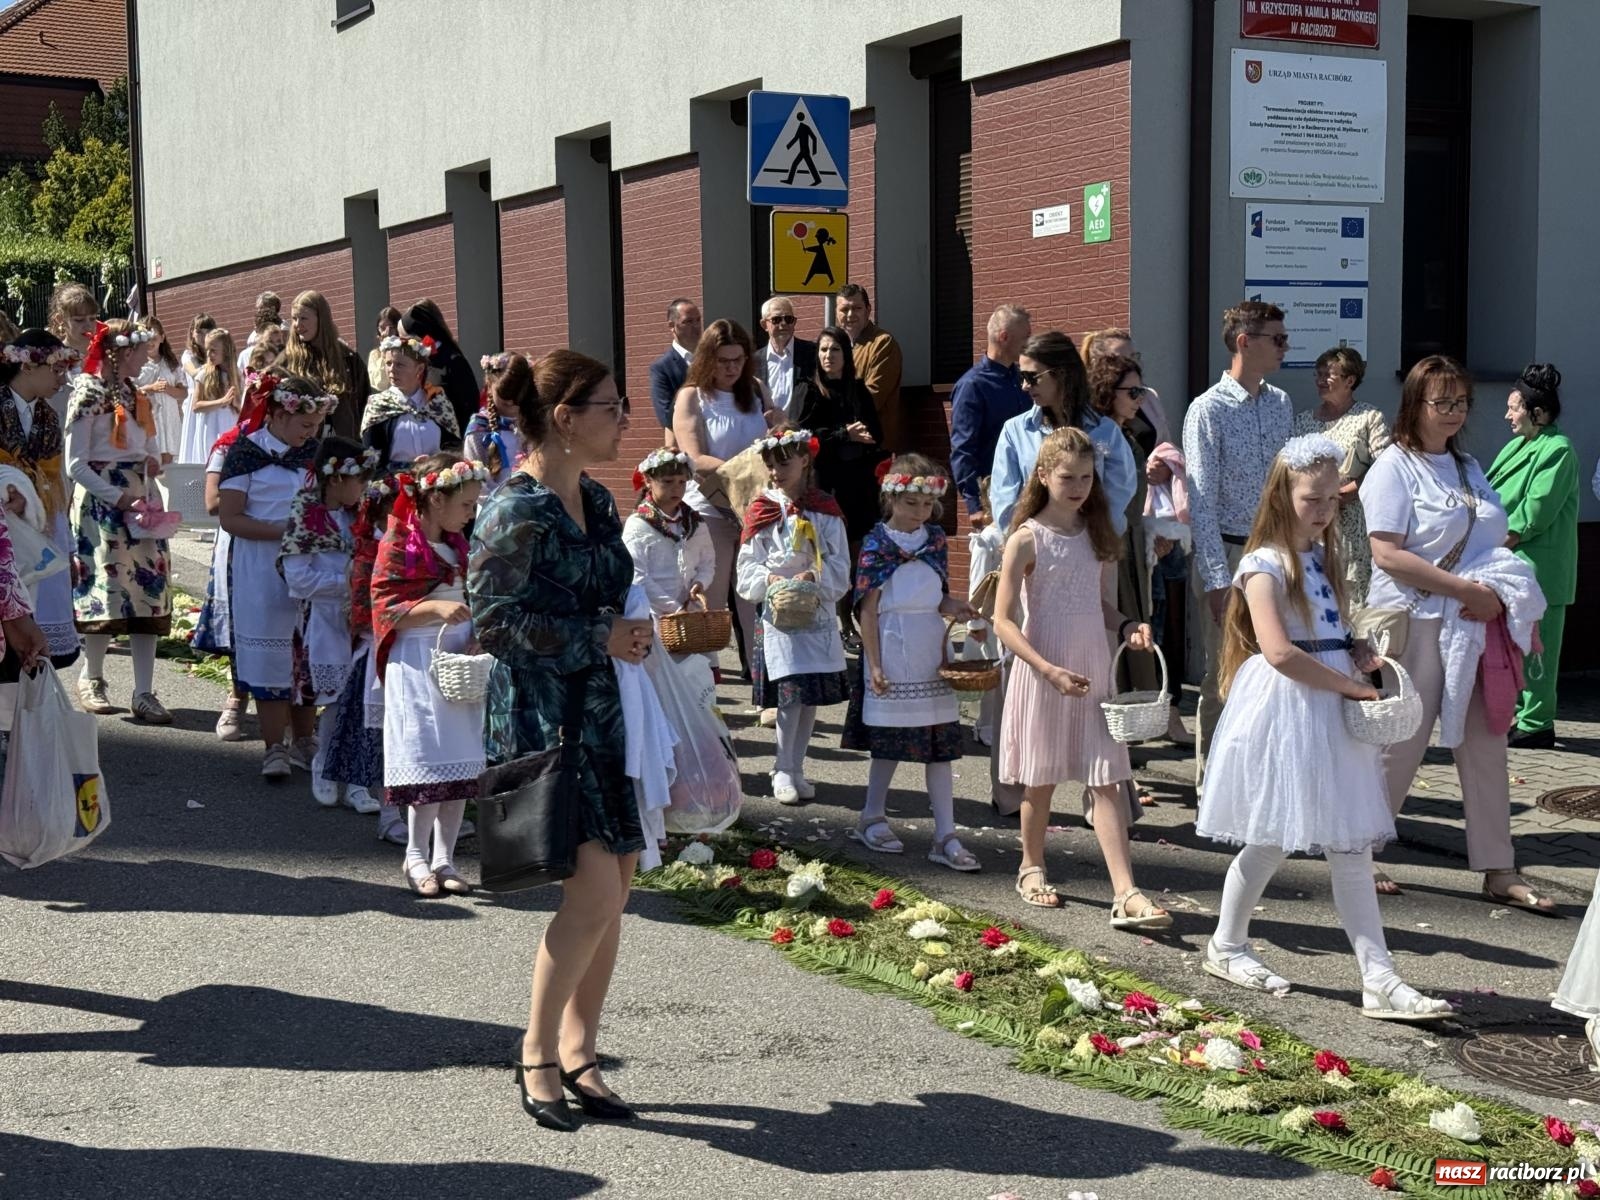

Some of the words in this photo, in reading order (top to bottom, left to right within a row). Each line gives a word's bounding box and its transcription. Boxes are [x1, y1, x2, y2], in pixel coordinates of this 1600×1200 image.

[1246, 1, 1258, 13] IM.
[1260, 2, 1303, 17] KRZYSZTOFA
[1304, 5, 1329, 20] KAMILA
[1331, 7, 1376, 24] BACZYŃSKIEGO
[1290, 21, 1299, 34] W
[1300, 22, 1337, 38] RACIBORZU
[1268, 69, 1292, 79] URZĄD
[1293, 71, 1318, 81] MIASTA
[1318, 72, 1353, 83] RACIBÓRZ
[1088, 219, 1105, 231] AED
